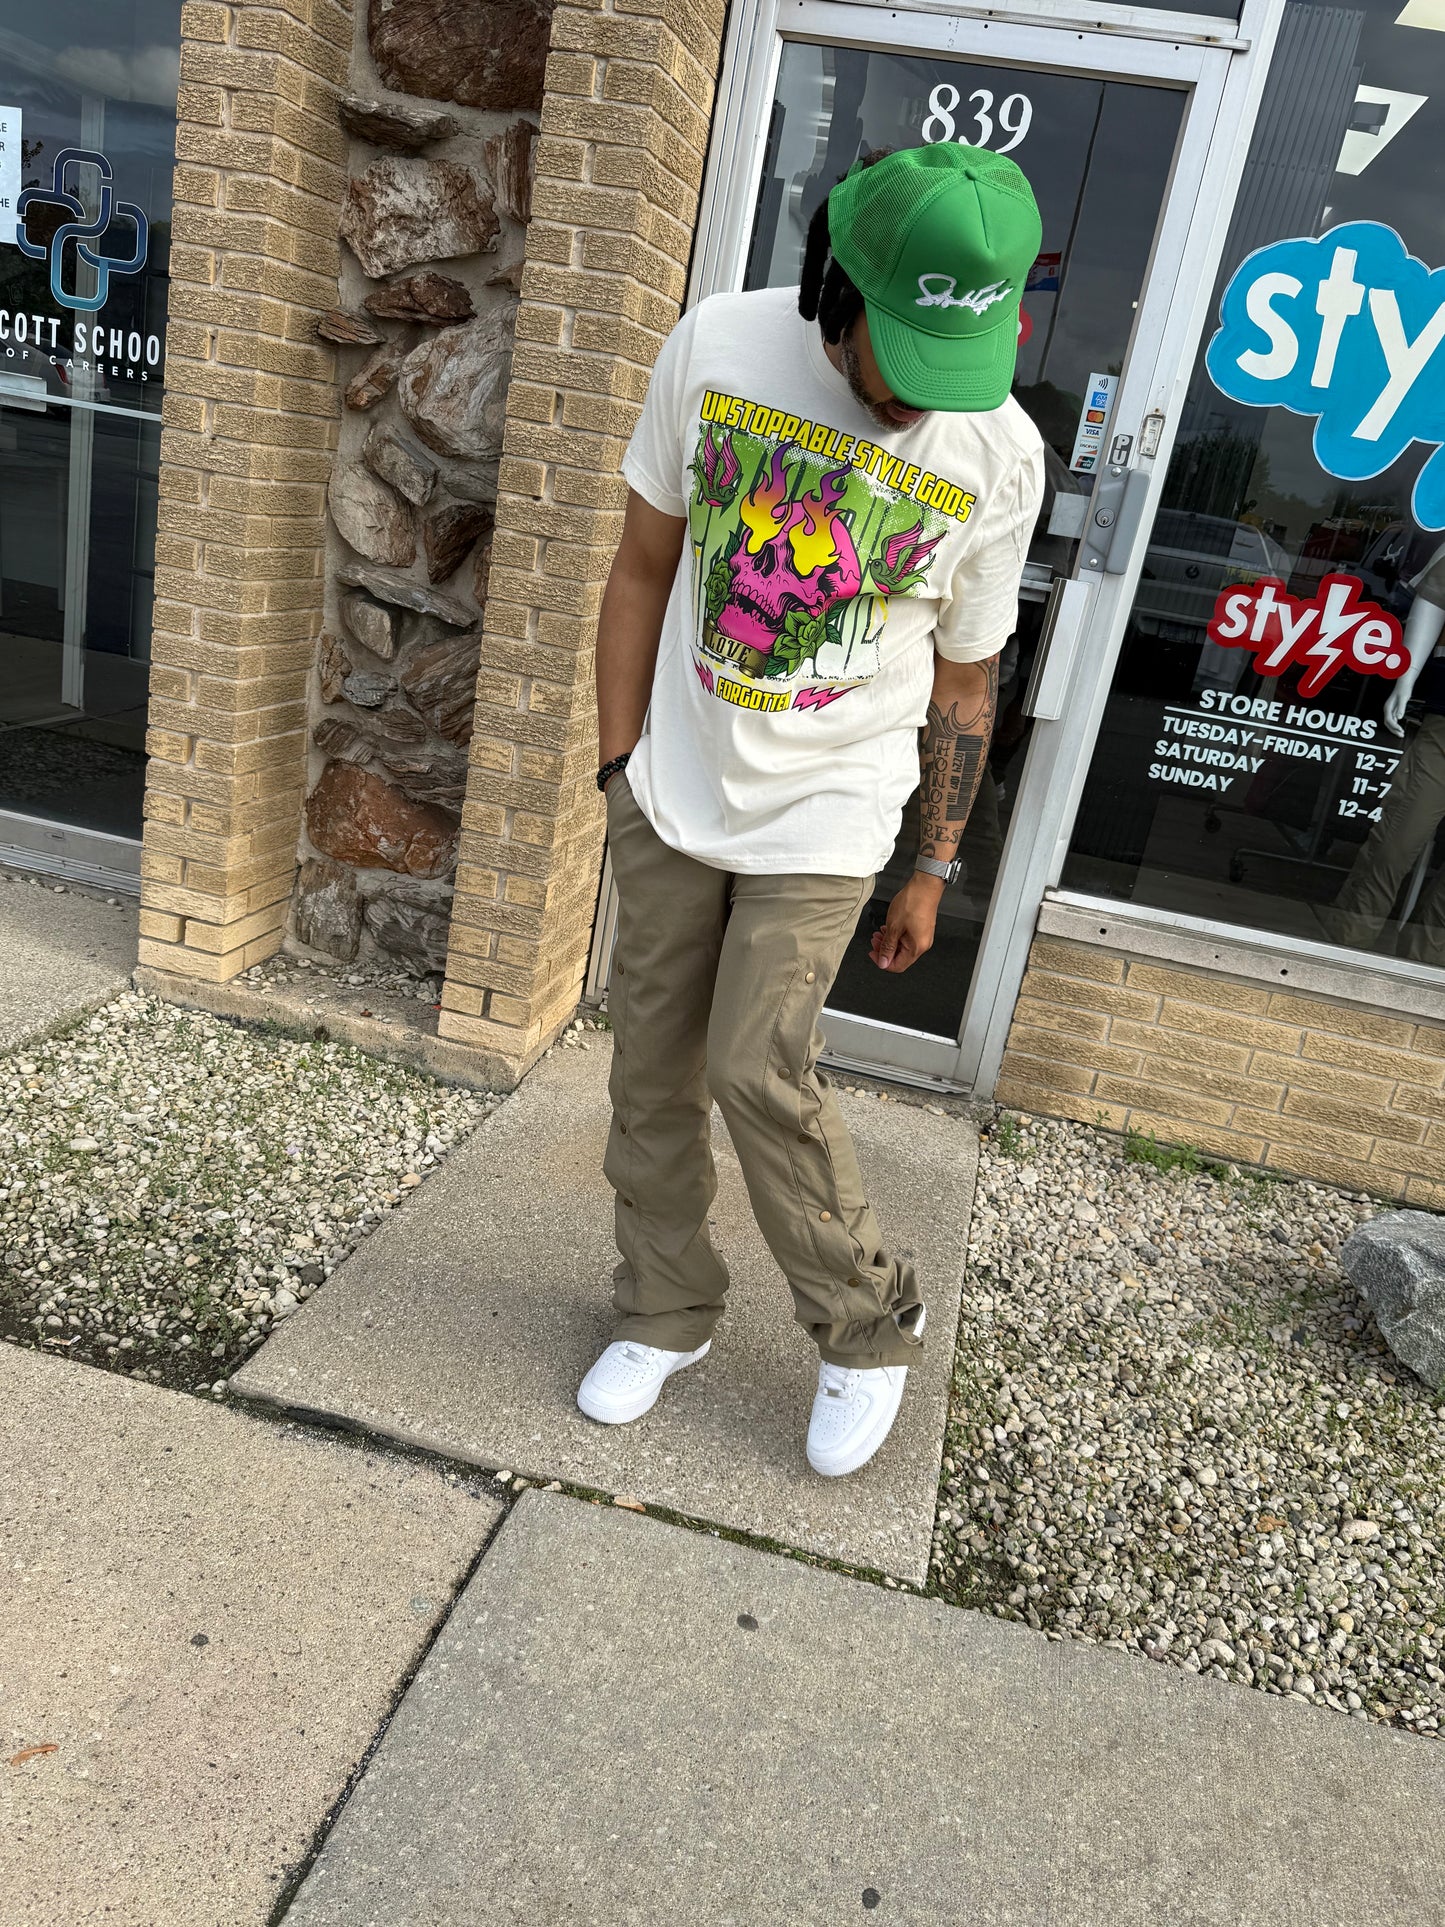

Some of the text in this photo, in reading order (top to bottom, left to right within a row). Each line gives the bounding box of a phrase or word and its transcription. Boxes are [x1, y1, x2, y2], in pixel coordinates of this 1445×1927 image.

[921, 83, 1033, 154] 839
[6, 347, 149, 381] OF CAREERS
[74, 322, 160, 366] SCHOO
[1235, 247, 1445, 441] sty
[700, 389, 978, 523] UNSTOPPABLE STYLE GODS
[1085, 428, 1100, 436] VISA
[709, 632, 752, 664] LOVE
[716, 677, 793, 713] FORGOTTEN
[1199, 689, 1378, 739] STORE HOURS
[1154, 739, 1393, 799] SATURDAY 11-7
[1162, 716, 1400, 775] TUESDAY-FRIDAY 12-7
[1148, 763, 1384, 823] SUNDAY 12-4
